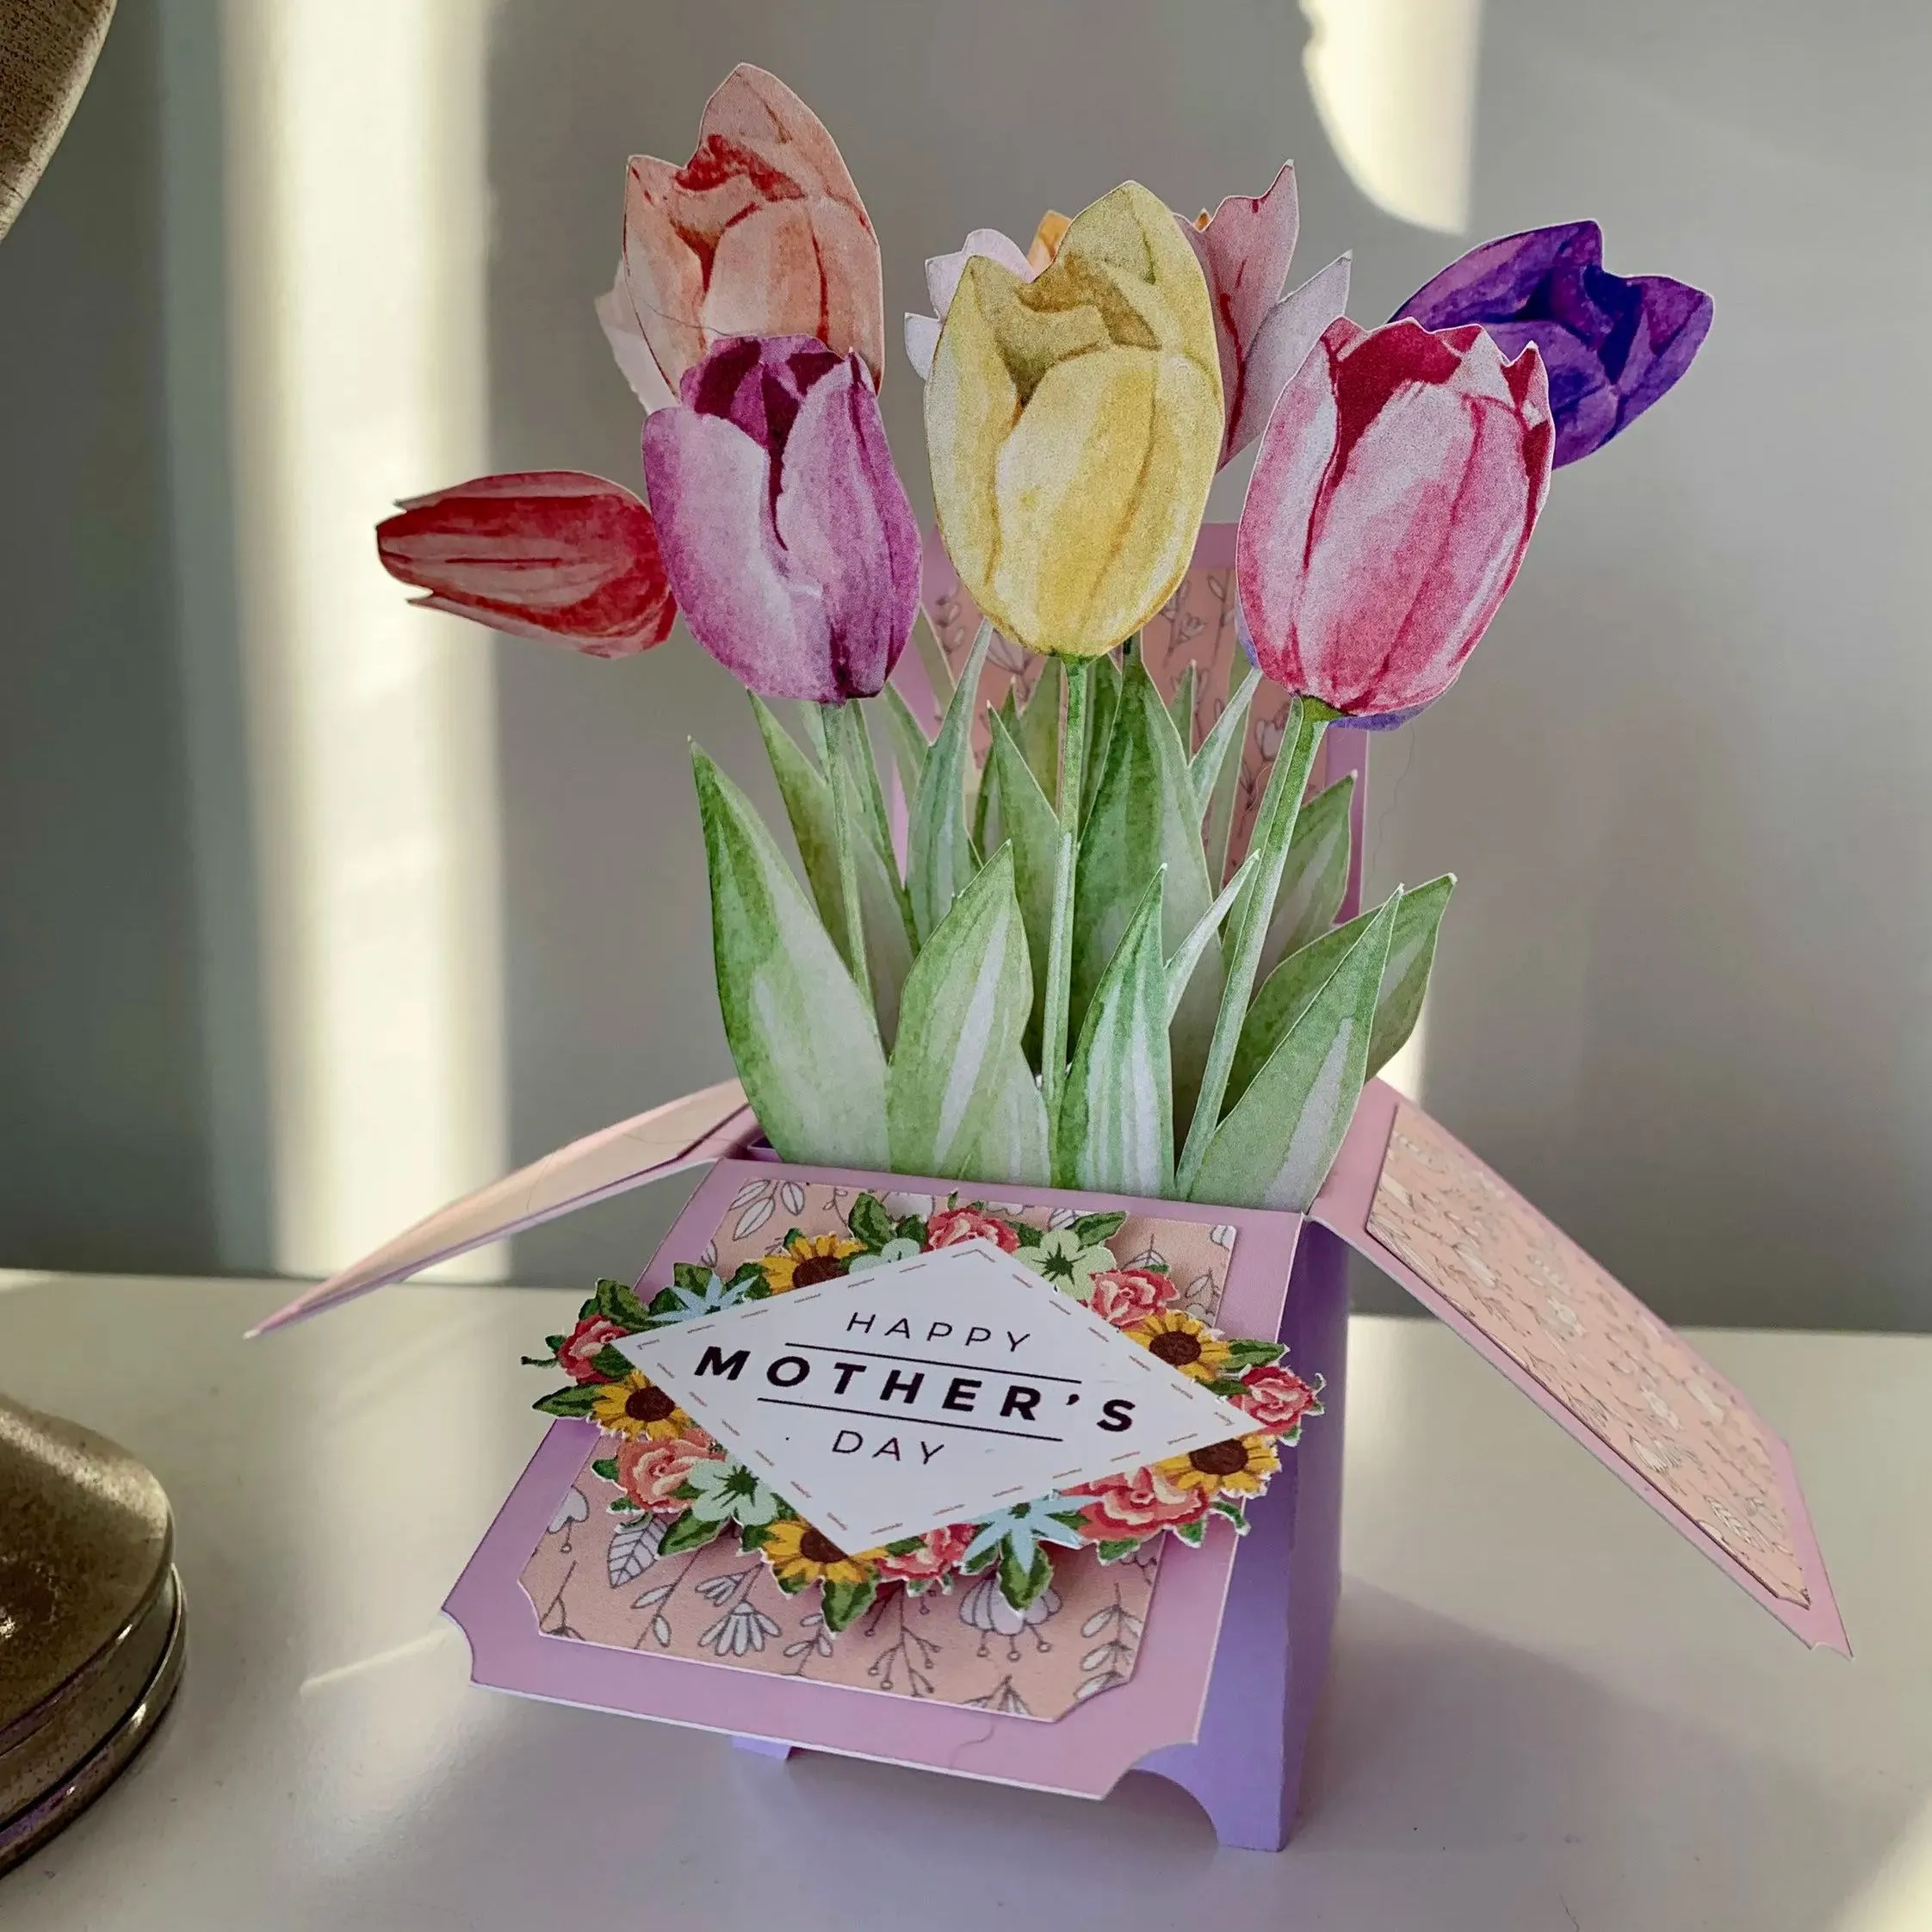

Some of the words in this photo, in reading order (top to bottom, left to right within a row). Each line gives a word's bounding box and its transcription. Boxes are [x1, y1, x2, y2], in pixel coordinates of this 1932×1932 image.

[845, 1311, 1031, 1353] HAPPY
[694, 1345, 1136, 1433] MOTHER'S
[831, 1429, 945, 1465] DAY
